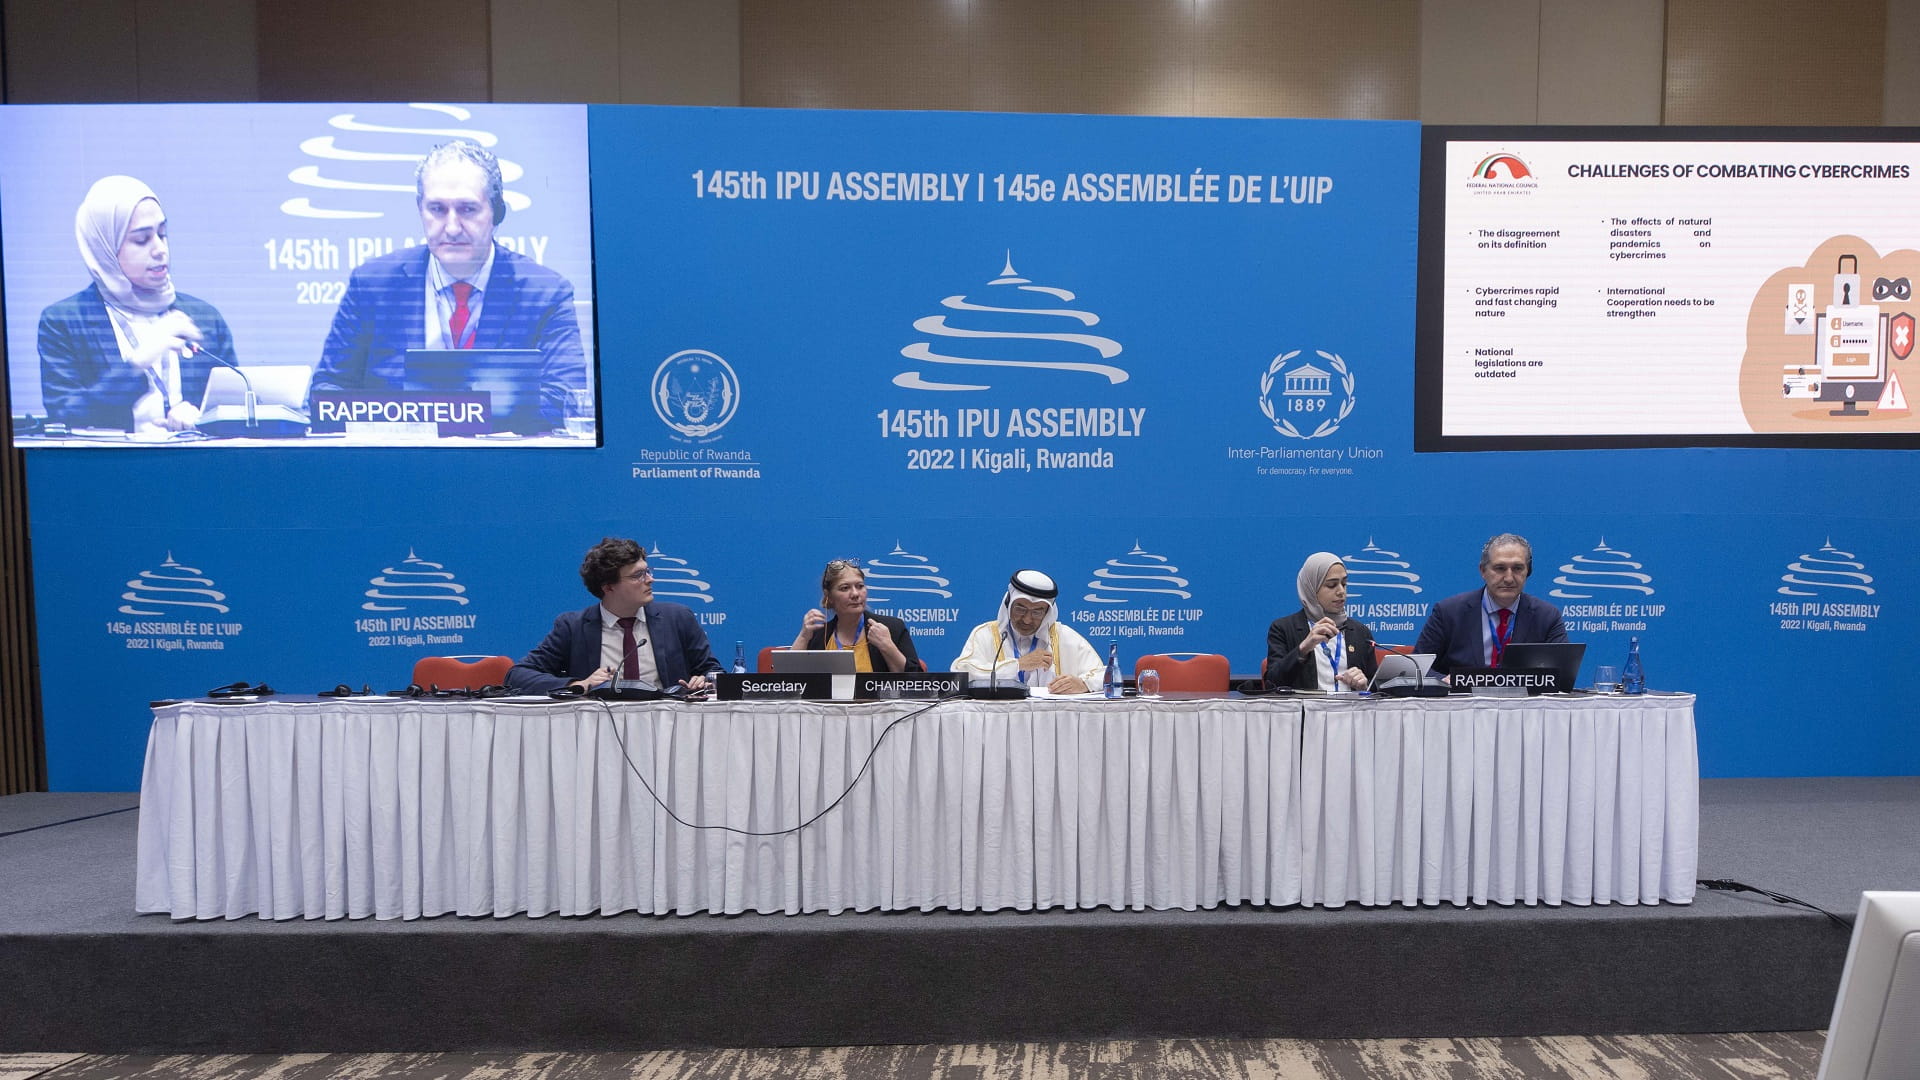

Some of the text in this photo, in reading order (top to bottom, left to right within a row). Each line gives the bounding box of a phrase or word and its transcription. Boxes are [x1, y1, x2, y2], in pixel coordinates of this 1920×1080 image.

[1567, 164, 1910, 179] CHALLENGES OF COMBATING CYBERCRIMES
[691, 169, 767, 200] 145th
[776, 170, 820, 201] IPU
[826, 171, 970, 202] ASSEMBLY
[993, 173, 1056, 202] 145e
[1061, 167, 1221, 203] ASSEMBLÉE
[1227, 174, 1263, 204] DE
[1611, 217, 1712, 226] The effects of natural
[1478, 228, 1560, 240] The disagreement
[1610, 228, 1712, 237] disasters and
[1491, 239, 1503, 249] its
[1503, 240, 1547, 249] definition
[1609, 239, 1661, 250] pandemics
[263, 237, 340, 272] 145th
[1609, 250, 1666, 262] cybercrimes
[296, 281, 346, 305] 2022
[1475, 286, 1560, 297] Cybercrimes rapid
[1607, 286, 1666, 295] International
[1475, 297, 1558, 309] and fast changing
[1606, 297, 1715, 309] Cooperation needs to be
[1475, 309, 1506, 317] nature
[1606, 309, 1656, 320] strengthen
[1474, 347, 1514, 356] National
[1474, 358, 1527, 370] legislations
[1474, 369, 1516, 378] outdated
[318, 400, 485, 423] RAPPORTEUR
[1288, 398, 1326, 412] 1889
[877, 407, 1146, 439] 145th IPU ASSEMBLY
[640, 448, 752, 463] Republic of Rwanda
[907, 448, 955, 470] 2022
[971, 447, 1031, 474] Kigali,
[1036, 447, 1114, 469] Rwanda
[1228, 446, 1384, 462] Inter-Parliamentary Union
[632, 466, 761, 479] Parliament of Rwanda
[1257, 466, 1269, 475] For
[1309, 466, 1321, 476] For
[1320, 467, 1354, 477] everyone.
[896, 608, 960, 623] ASSEMBLY
[1070, 610, 1096, 623] 145e
[1097, 606, 1160, 623] ASSEMBLÉE
[1161, 609, 1176, 622] DE
[1346, 603, 1429, 618] IPU ASSEMBLY
[1561, 602, 1623, 618] ASSEMBLÉE
[1624, 604, 1639, 617] DE
[1769, 602, 1881, 618] 145th IPU ASSEMBLY
[106, 621, 133, 635] 145e
[133, 620, 198, 636] ASSEMBLÉE
[199, 622, 215, 636] DE
[354, 614, 477, 633] 145th IPU ASSEMBLY
[1379, 620, 1415, 631] Rwanda
[1582, 620, 1610, 633] Kigali,
[1610, 620, 1647, 631] Rwanda
[1780, 619, 1801, 630] 2022
[1806, 619, 1832, 632] Kigali,
[1833, 620, 1867, 632] Rwanda
[909, 626, 945, 637] Rwanda
[1089, 625, 1112, 637] 2022
[1118, 625, 1146, 638] Kigali,
[1147, 625, 1185, 637] Rwanda
[126, 638, 150, 649] 2022
[155, 638, 186, 652] Kigali,
[186, 638, 225, 650] Rwanda
[368, 635, 392, 647] 2022
[397, 634, 426, 648] Kigali,
[426, 632, 464, 645] Rwanda
[741, 679, 807, 695] Secretary
[865, 680, 960, 692] CHAIRPERSON
[1455, 674, 1556, 688] RAPPORTEUR
